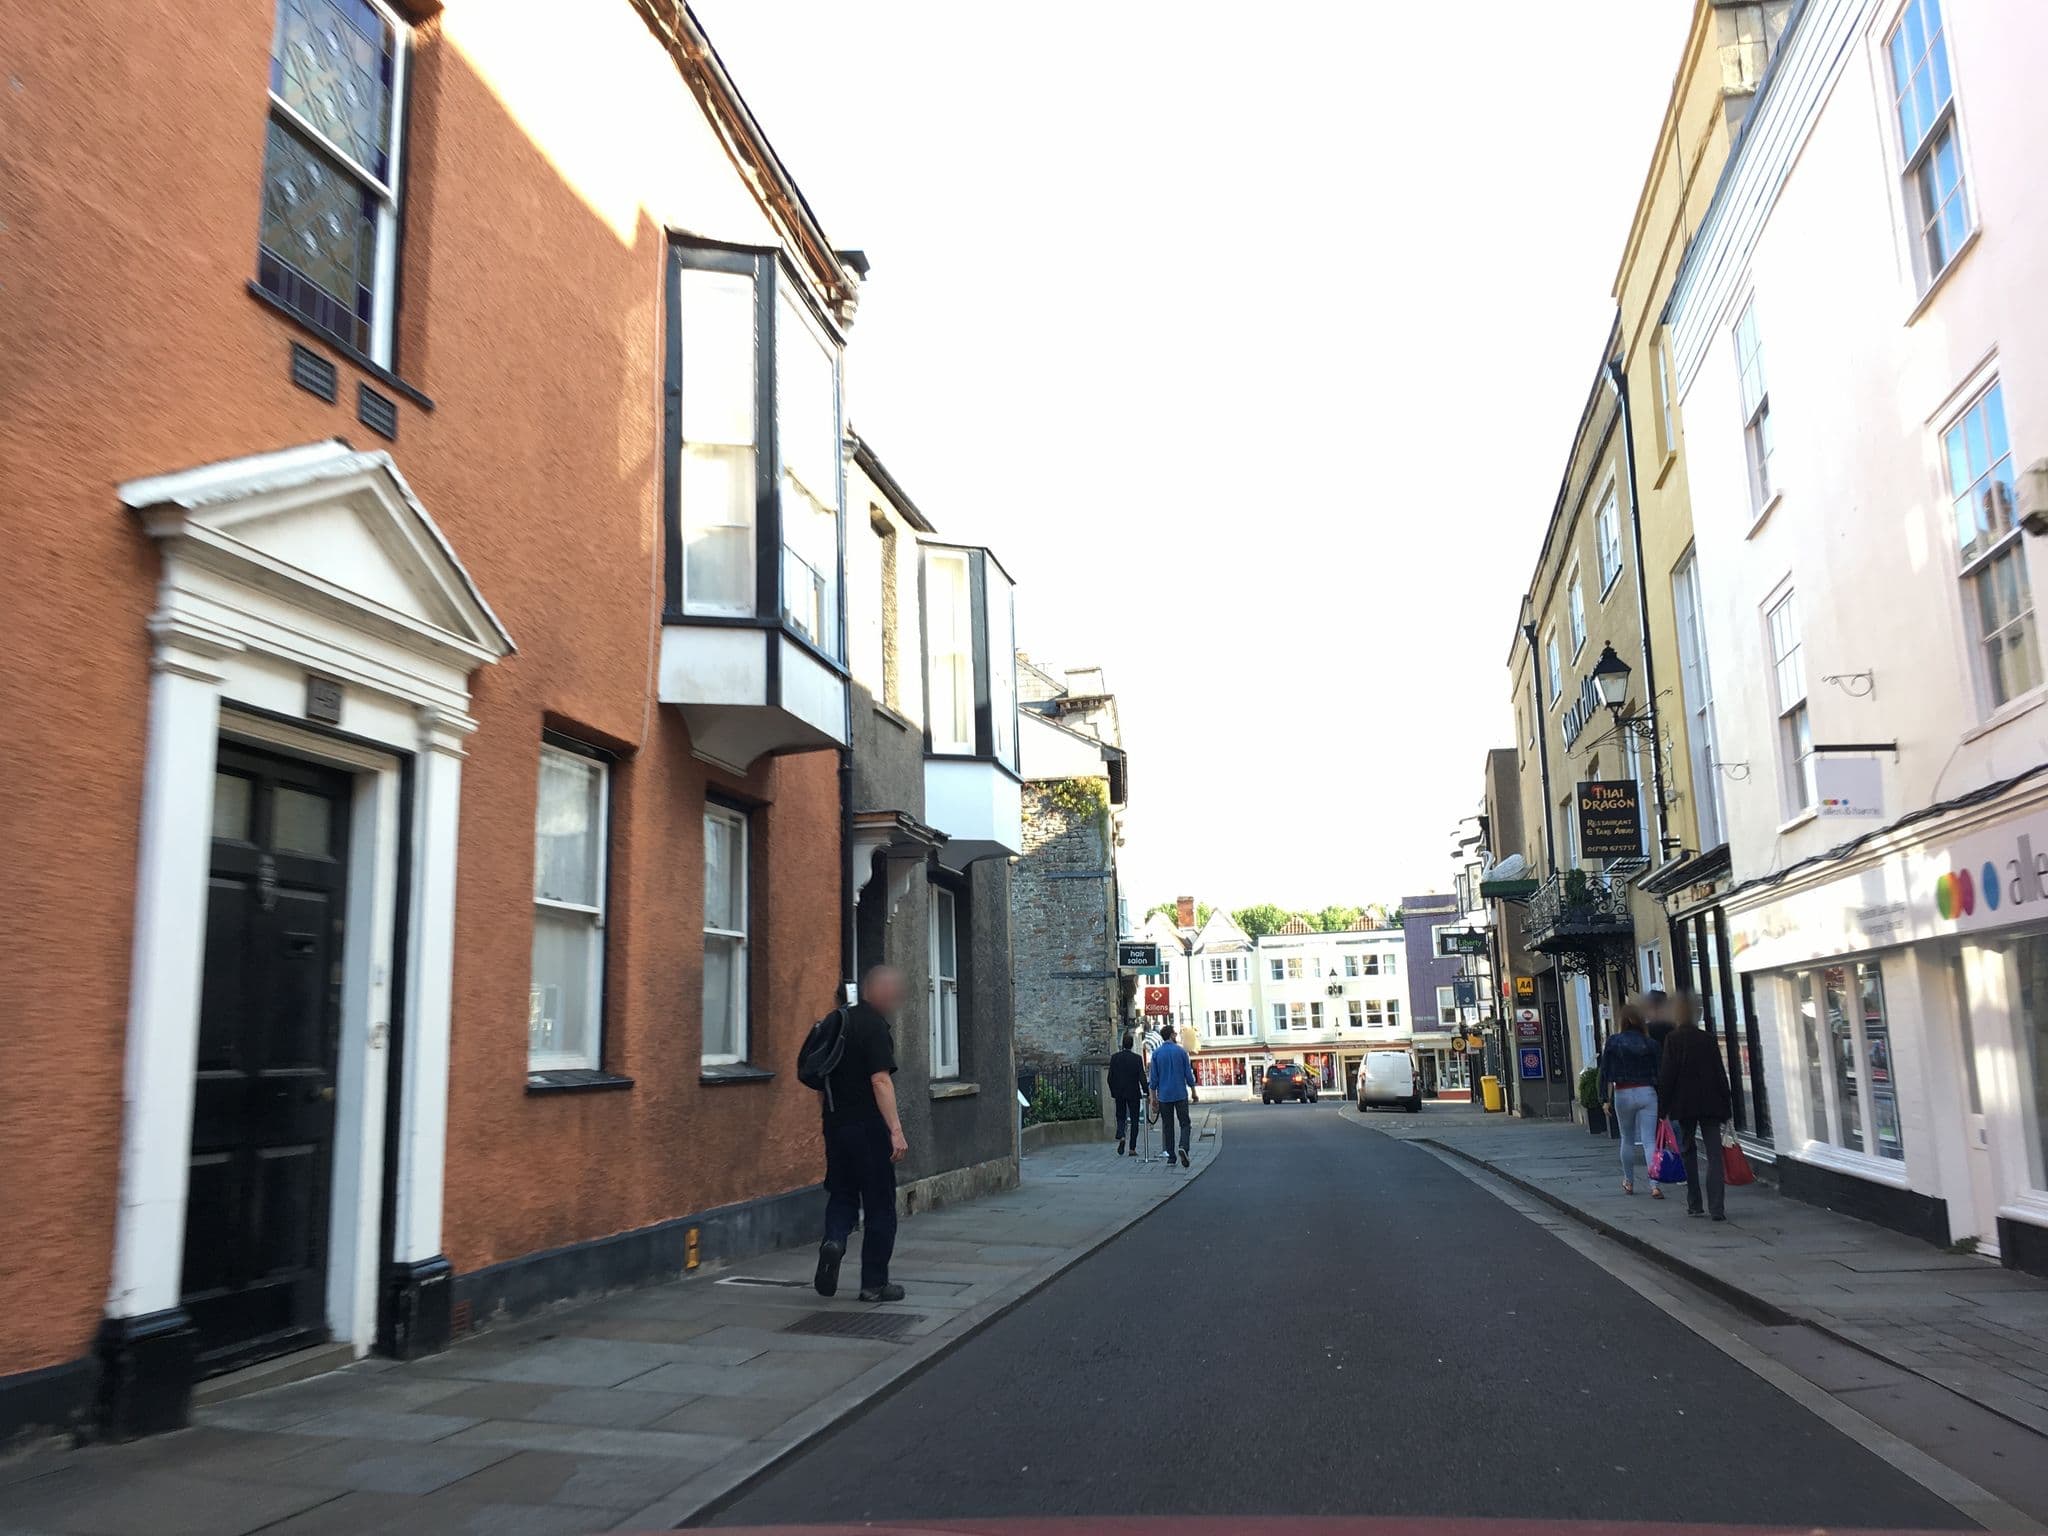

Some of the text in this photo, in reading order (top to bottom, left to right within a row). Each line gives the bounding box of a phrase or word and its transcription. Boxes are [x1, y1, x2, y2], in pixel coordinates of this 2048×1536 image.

[1582, 799, 1635, 812] DRAGON
[1520, 981, 1531, 989] AA
[1145, 1003, 1169, 1011] Killens
